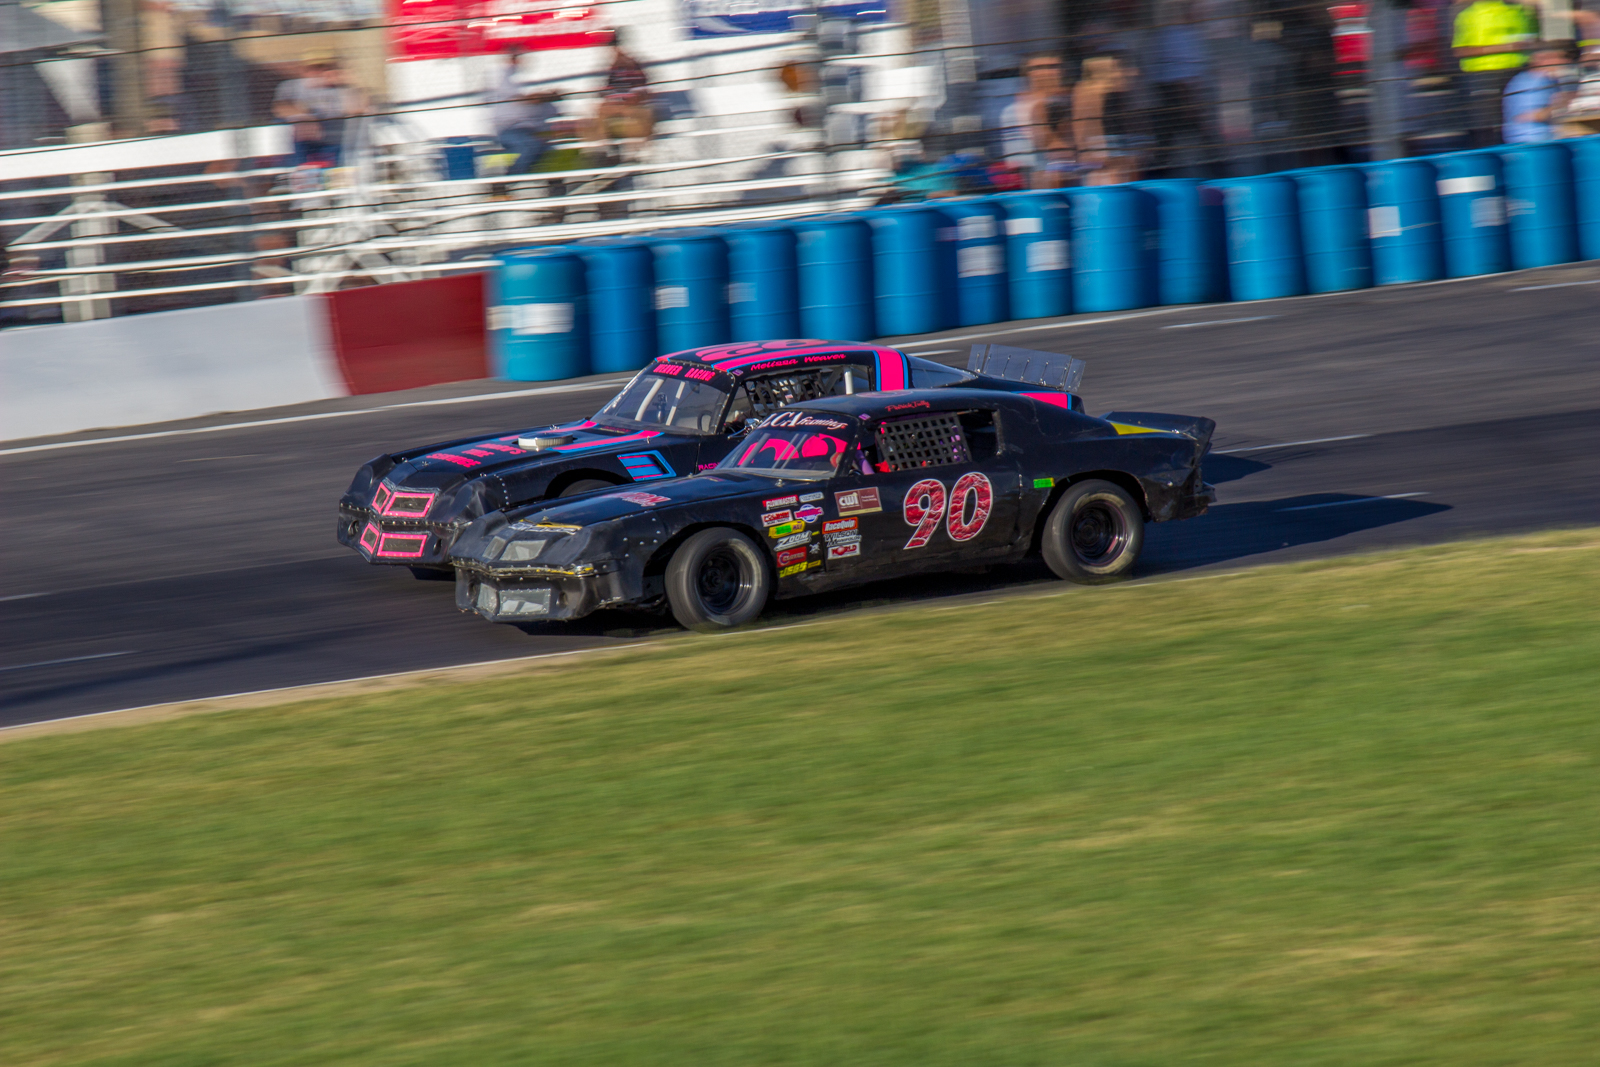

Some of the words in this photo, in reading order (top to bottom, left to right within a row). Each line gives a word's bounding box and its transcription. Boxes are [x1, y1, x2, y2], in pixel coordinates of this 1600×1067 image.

[750, 359, 798, 371] Melissa
[804, 353, 847, 363] Weaver
[653, 363, 683, 376] WEAVER
[684, 367, 716, 381] RACING
[698, 462, 720, 471] RACIN
[903, 471, 993, 550] 90
